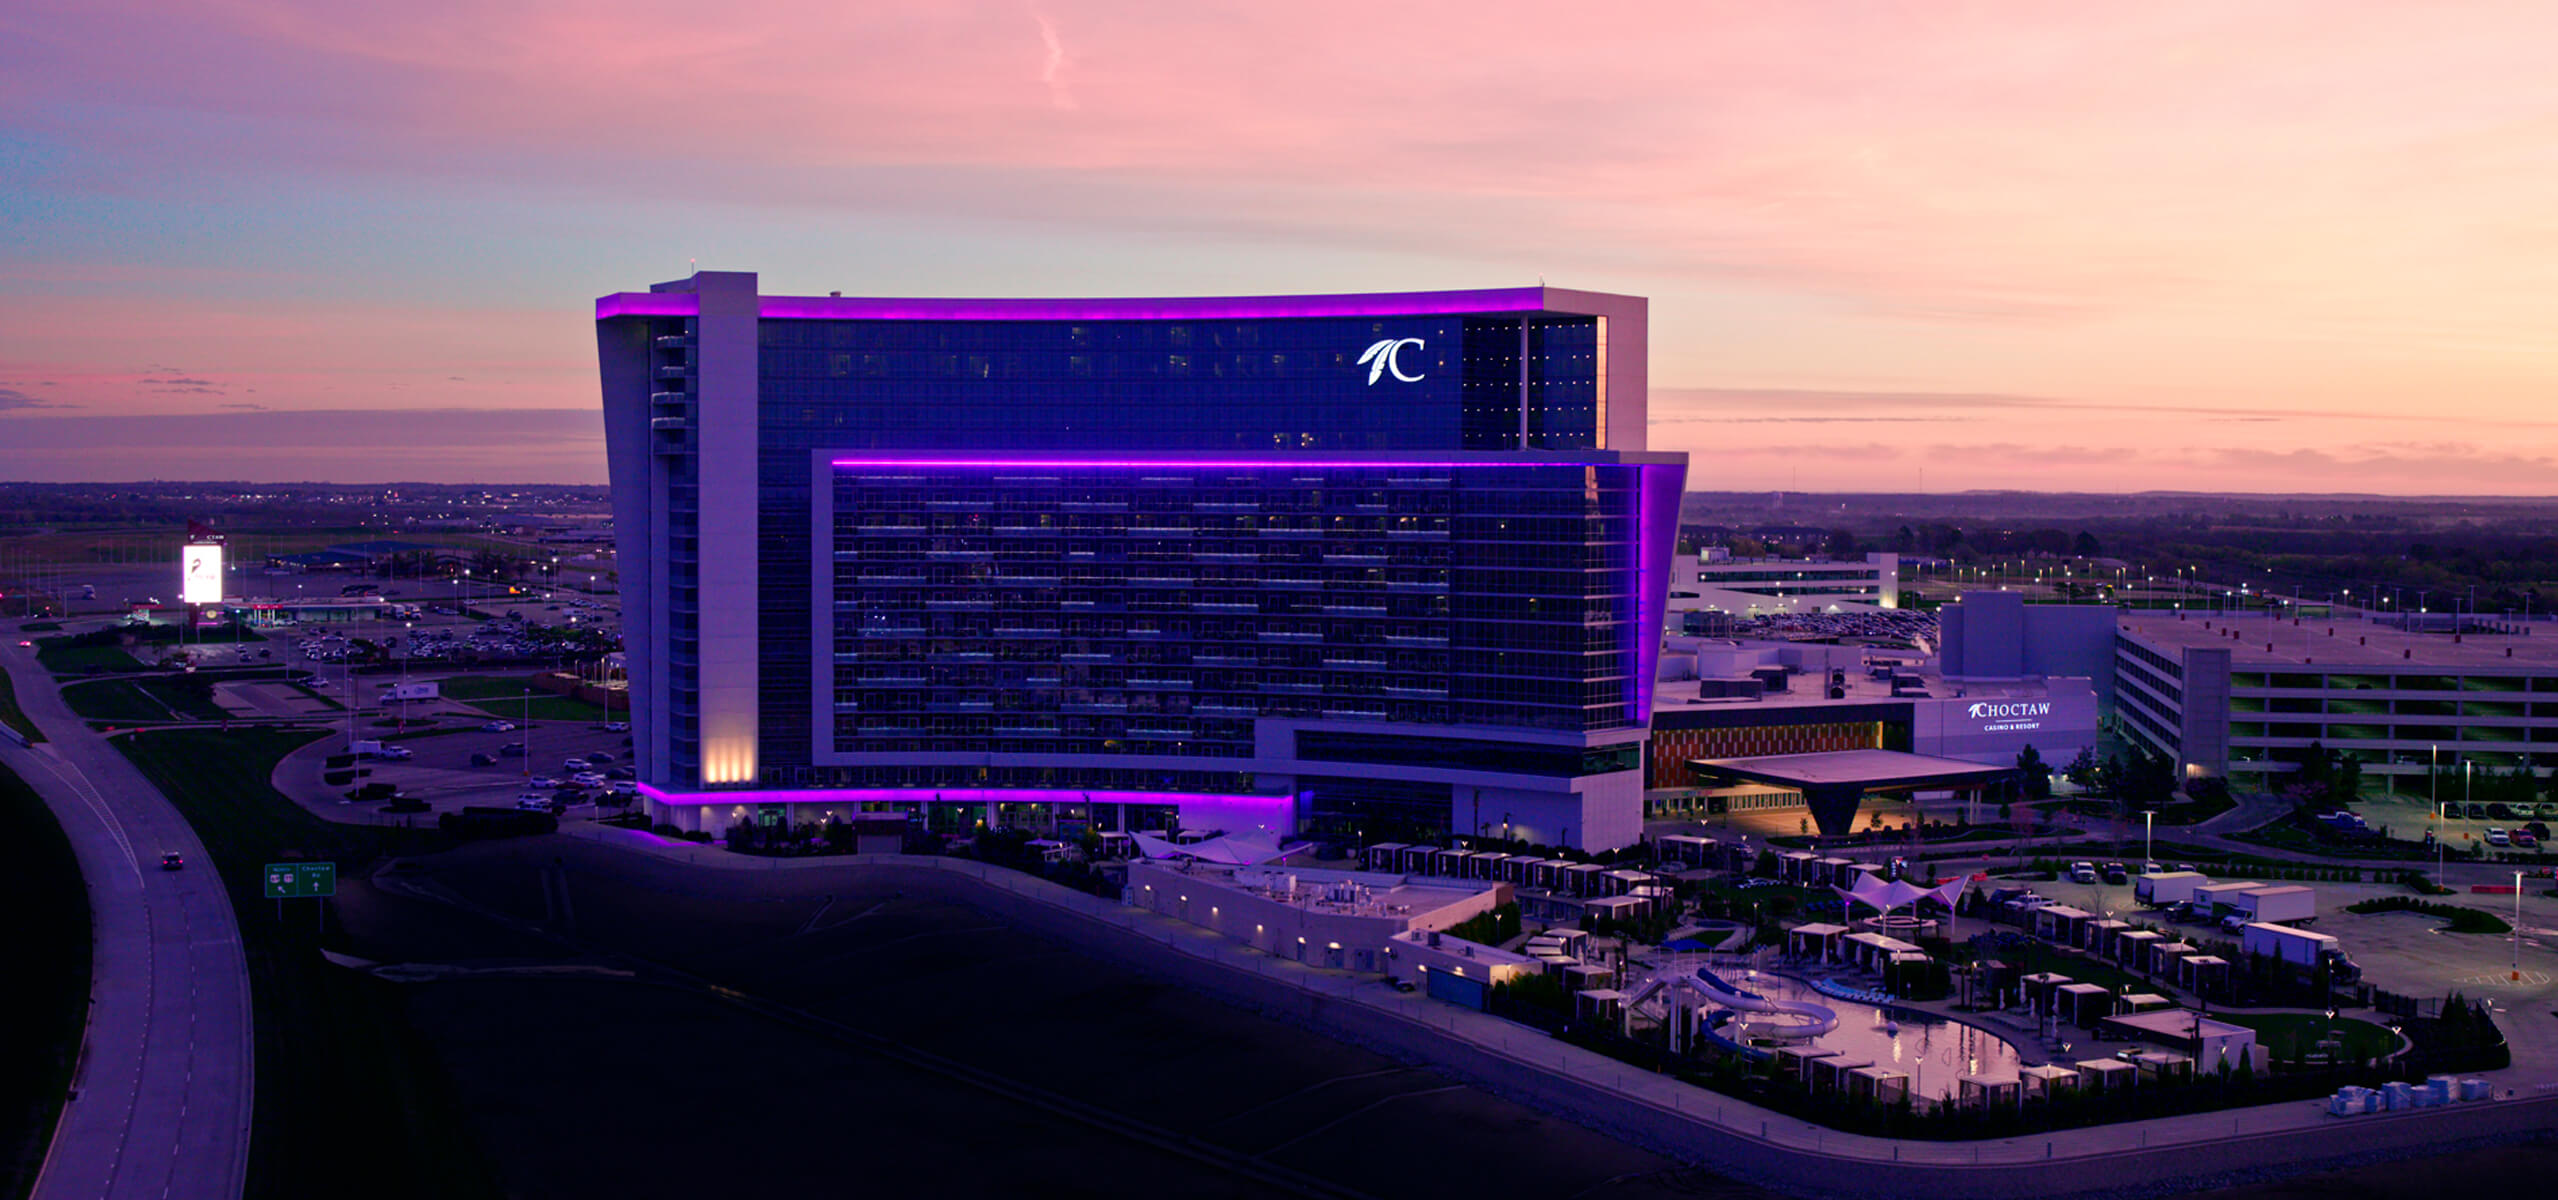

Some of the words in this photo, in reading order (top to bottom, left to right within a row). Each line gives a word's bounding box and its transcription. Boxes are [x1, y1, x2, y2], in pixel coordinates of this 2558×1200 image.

[1975, 702, 2050, 717] CHOCTAW
[1984, 723, 2009, 732] CASINO
[2016, 722, 2040, 730] RESORT
